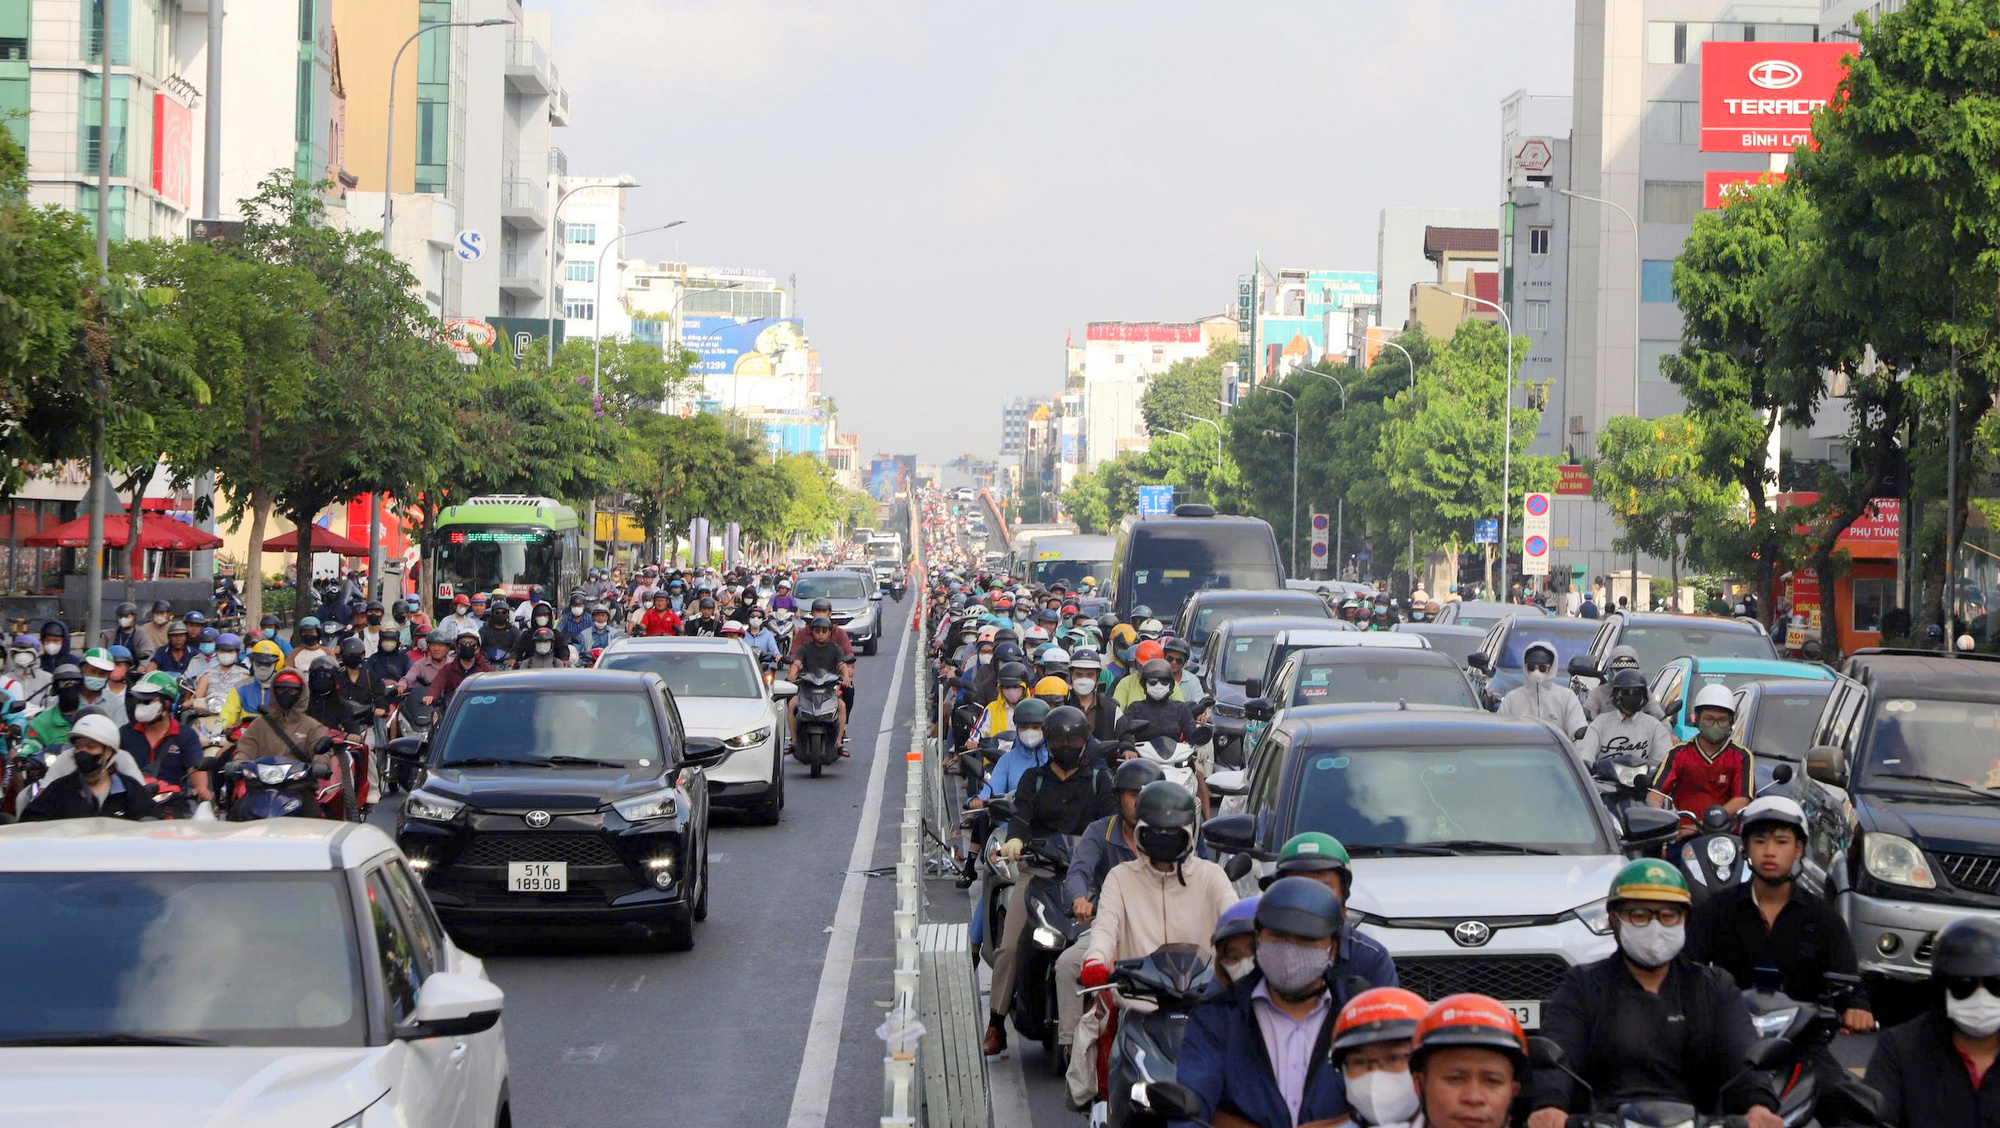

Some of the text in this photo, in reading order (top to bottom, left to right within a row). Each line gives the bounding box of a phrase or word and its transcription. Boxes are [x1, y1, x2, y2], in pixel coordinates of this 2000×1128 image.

[1742, 132, 1777, 146] BÌNH
[706, 361, 726, 370] 1299
[1850, 527, 1871, 538] PHỤ
[440, 586, 451, 596] 04
[1601, 737, 1648, 753] Smart
[525, 865, 549, 876] 51K
[516, 878, 560, 890] 189.08
